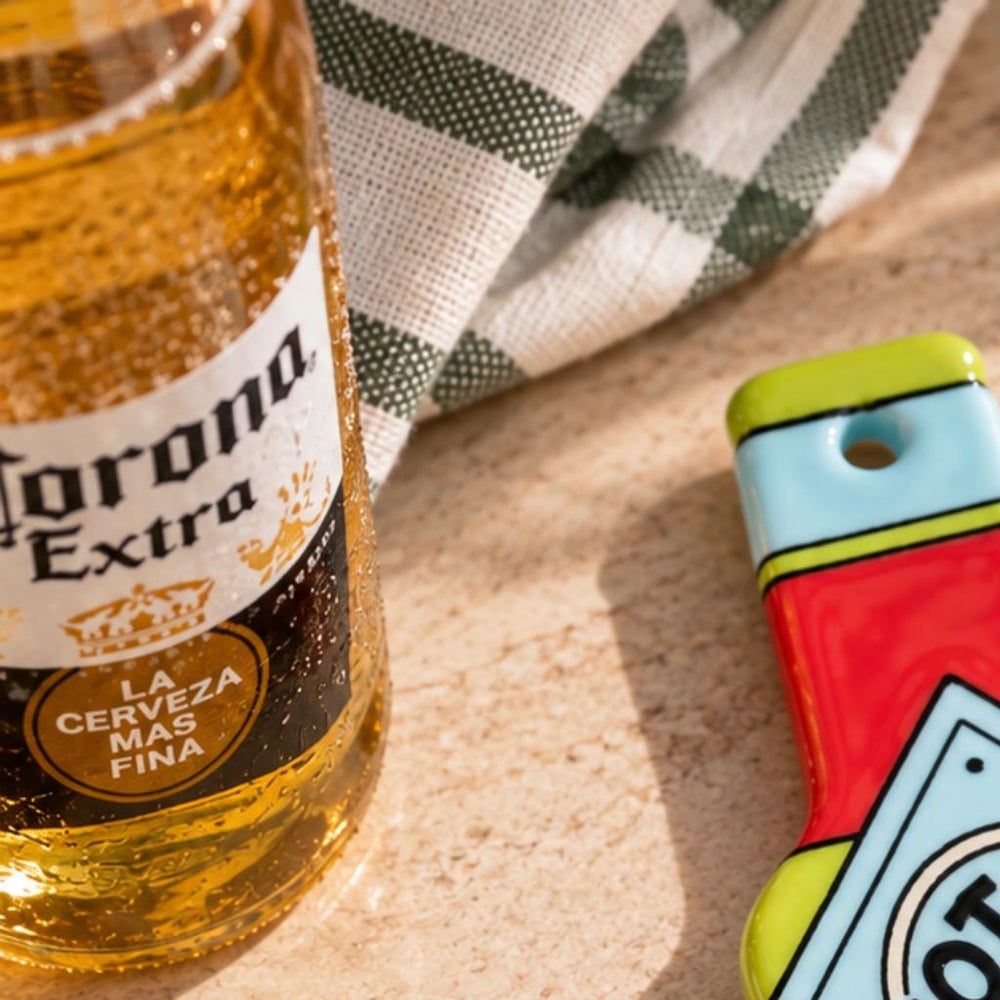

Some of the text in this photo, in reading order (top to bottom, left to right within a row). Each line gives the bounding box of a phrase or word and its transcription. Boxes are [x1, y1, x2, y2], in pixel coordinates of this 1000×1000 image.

[0, 324, 309, 548] orona
[26, 478, 257, 583] Extra
[56, 666, 243, 734] CERVEZA
[121, 670, 176, 701] LA
[110, 712, 197, 753] MAS
[110, 737, 205, 779] FINA
